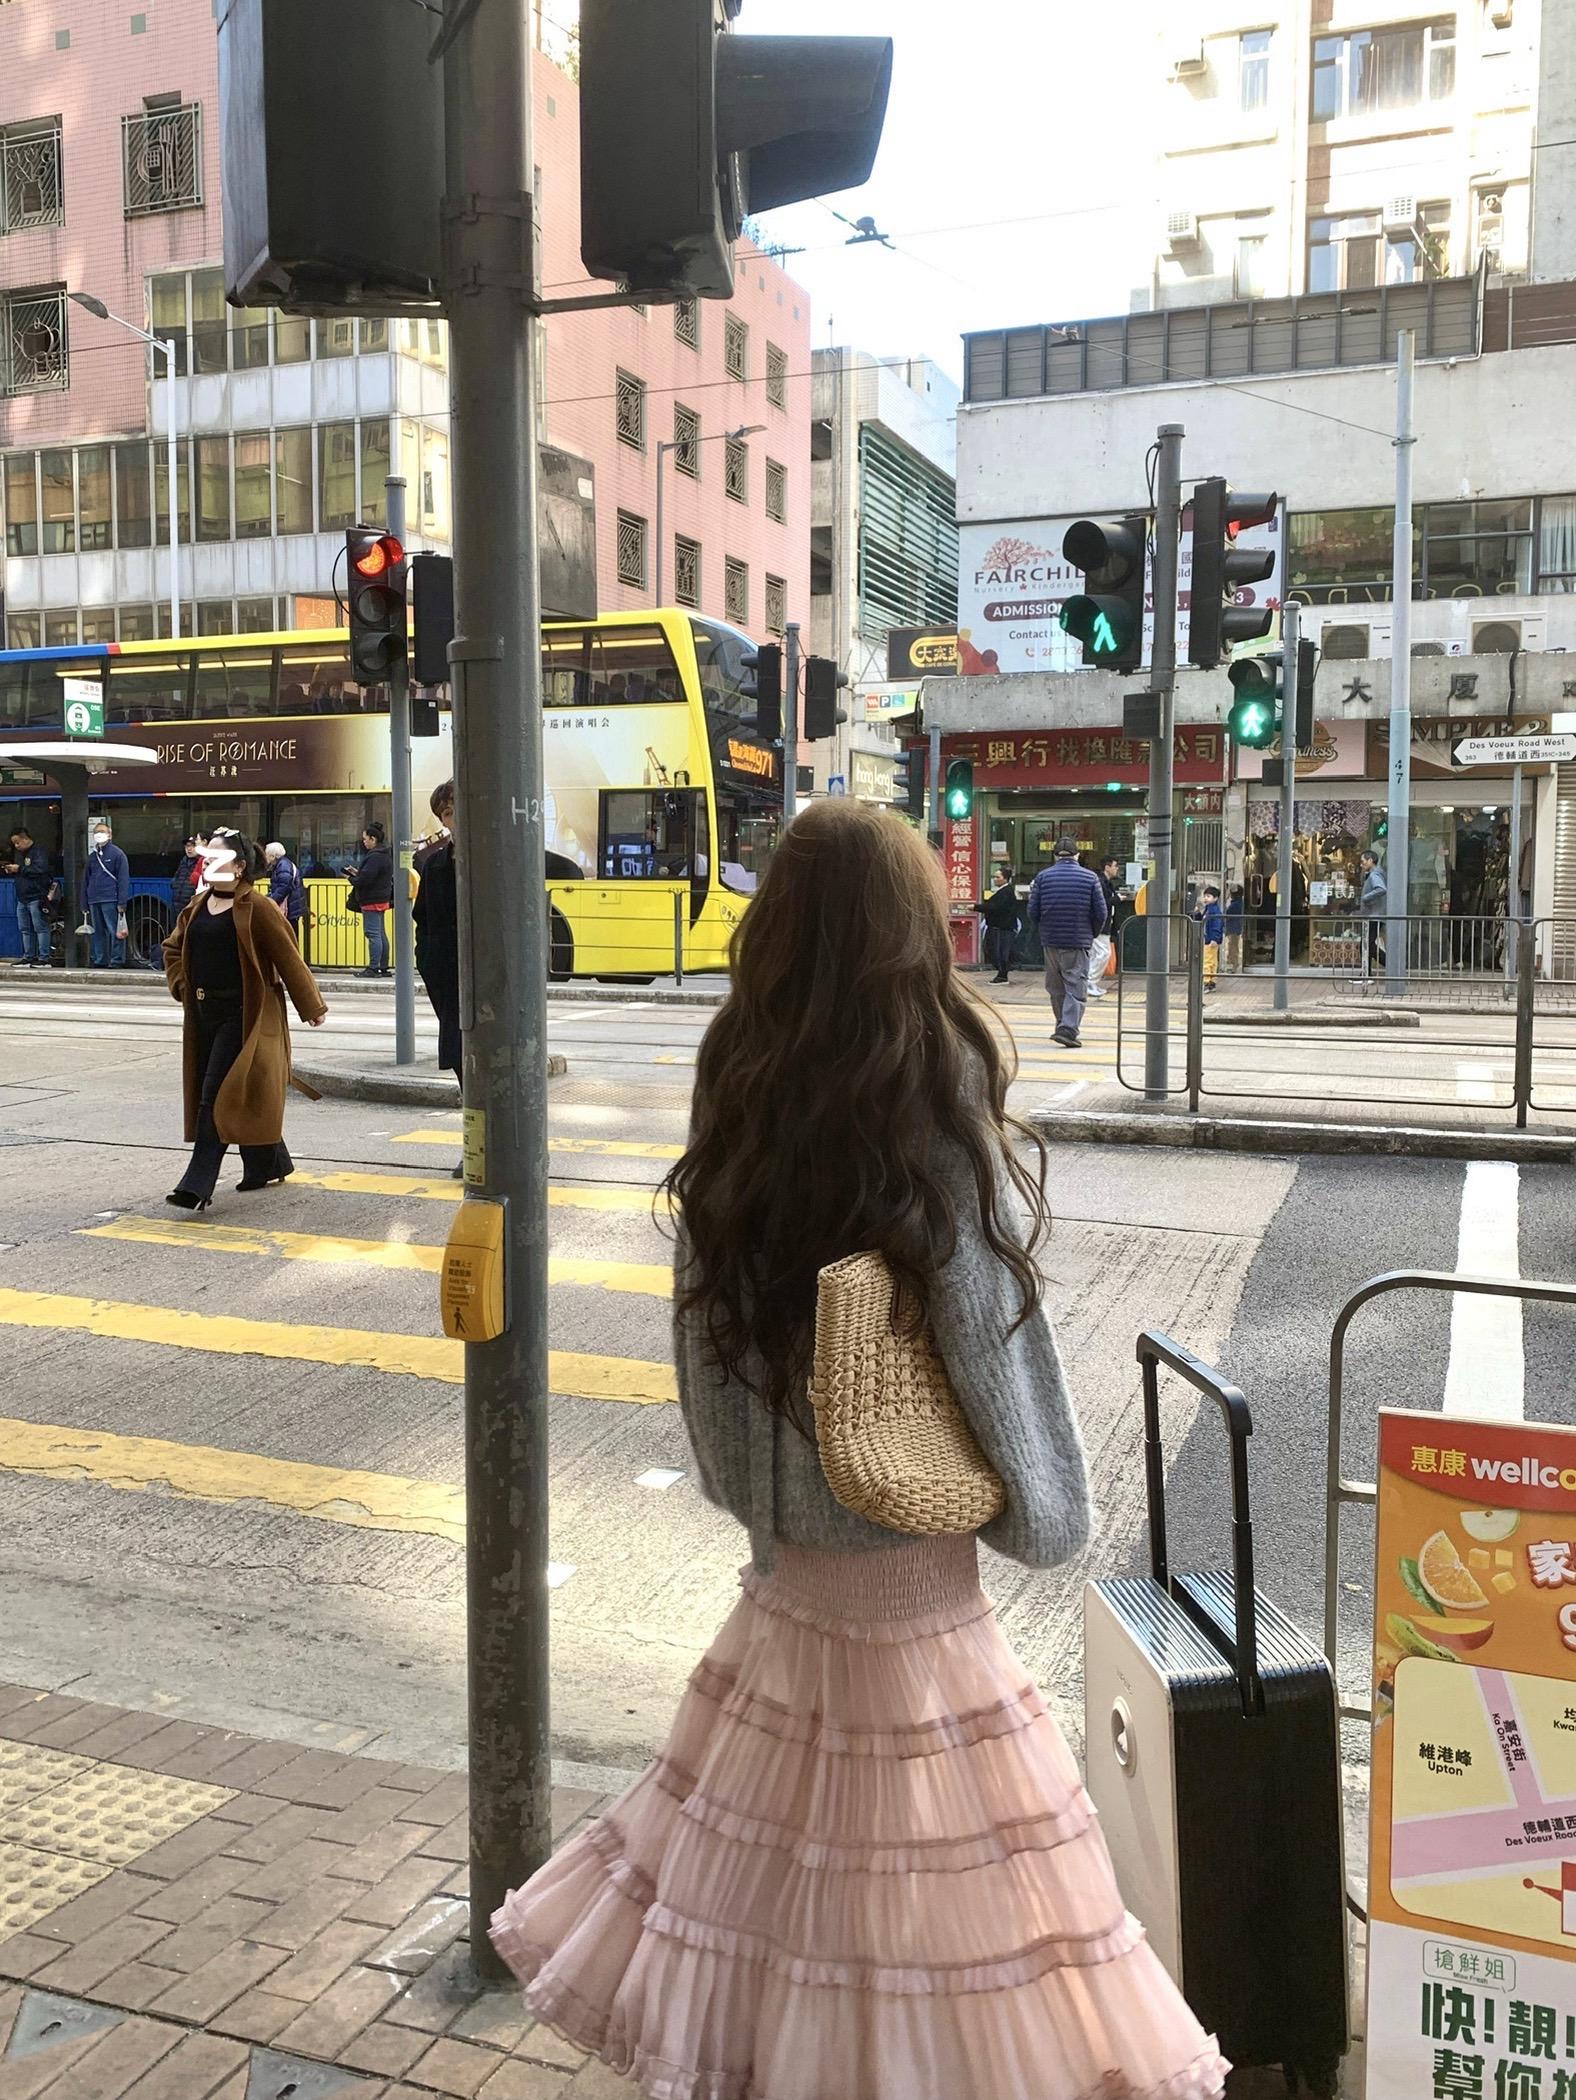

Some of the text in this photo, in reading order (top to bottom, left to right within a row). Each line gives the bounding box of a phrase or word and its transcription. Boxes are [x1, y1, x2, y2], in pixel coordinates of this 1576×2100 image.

[974, 566, 1086, 584] FAIRCHIL
[1009, 630, 1048, 640] Contact
[1544, 737, 1565, 745] West
[157, 739, 297, 764] RISE OF ROMANCE
[318, 914, 361, 927] Citybus
[1411, 1445, 1467, 1477] 惠康
[1471, 1457, 1576, 1491] wellco
[1553, 1720, 1576, 1732] Kwa
[1492, 1712, 1516, 1772] Ka On Street
[1503, 1719, 1527, 1762] 嘉安街
[1418, 1742, 1472, 1767] 維港峰
[1428, 1760, 1463, 1776] Upton
[1505, 1837, 1524, 1847] Des
[1525, 1832, 1553, 1844] Voeux
